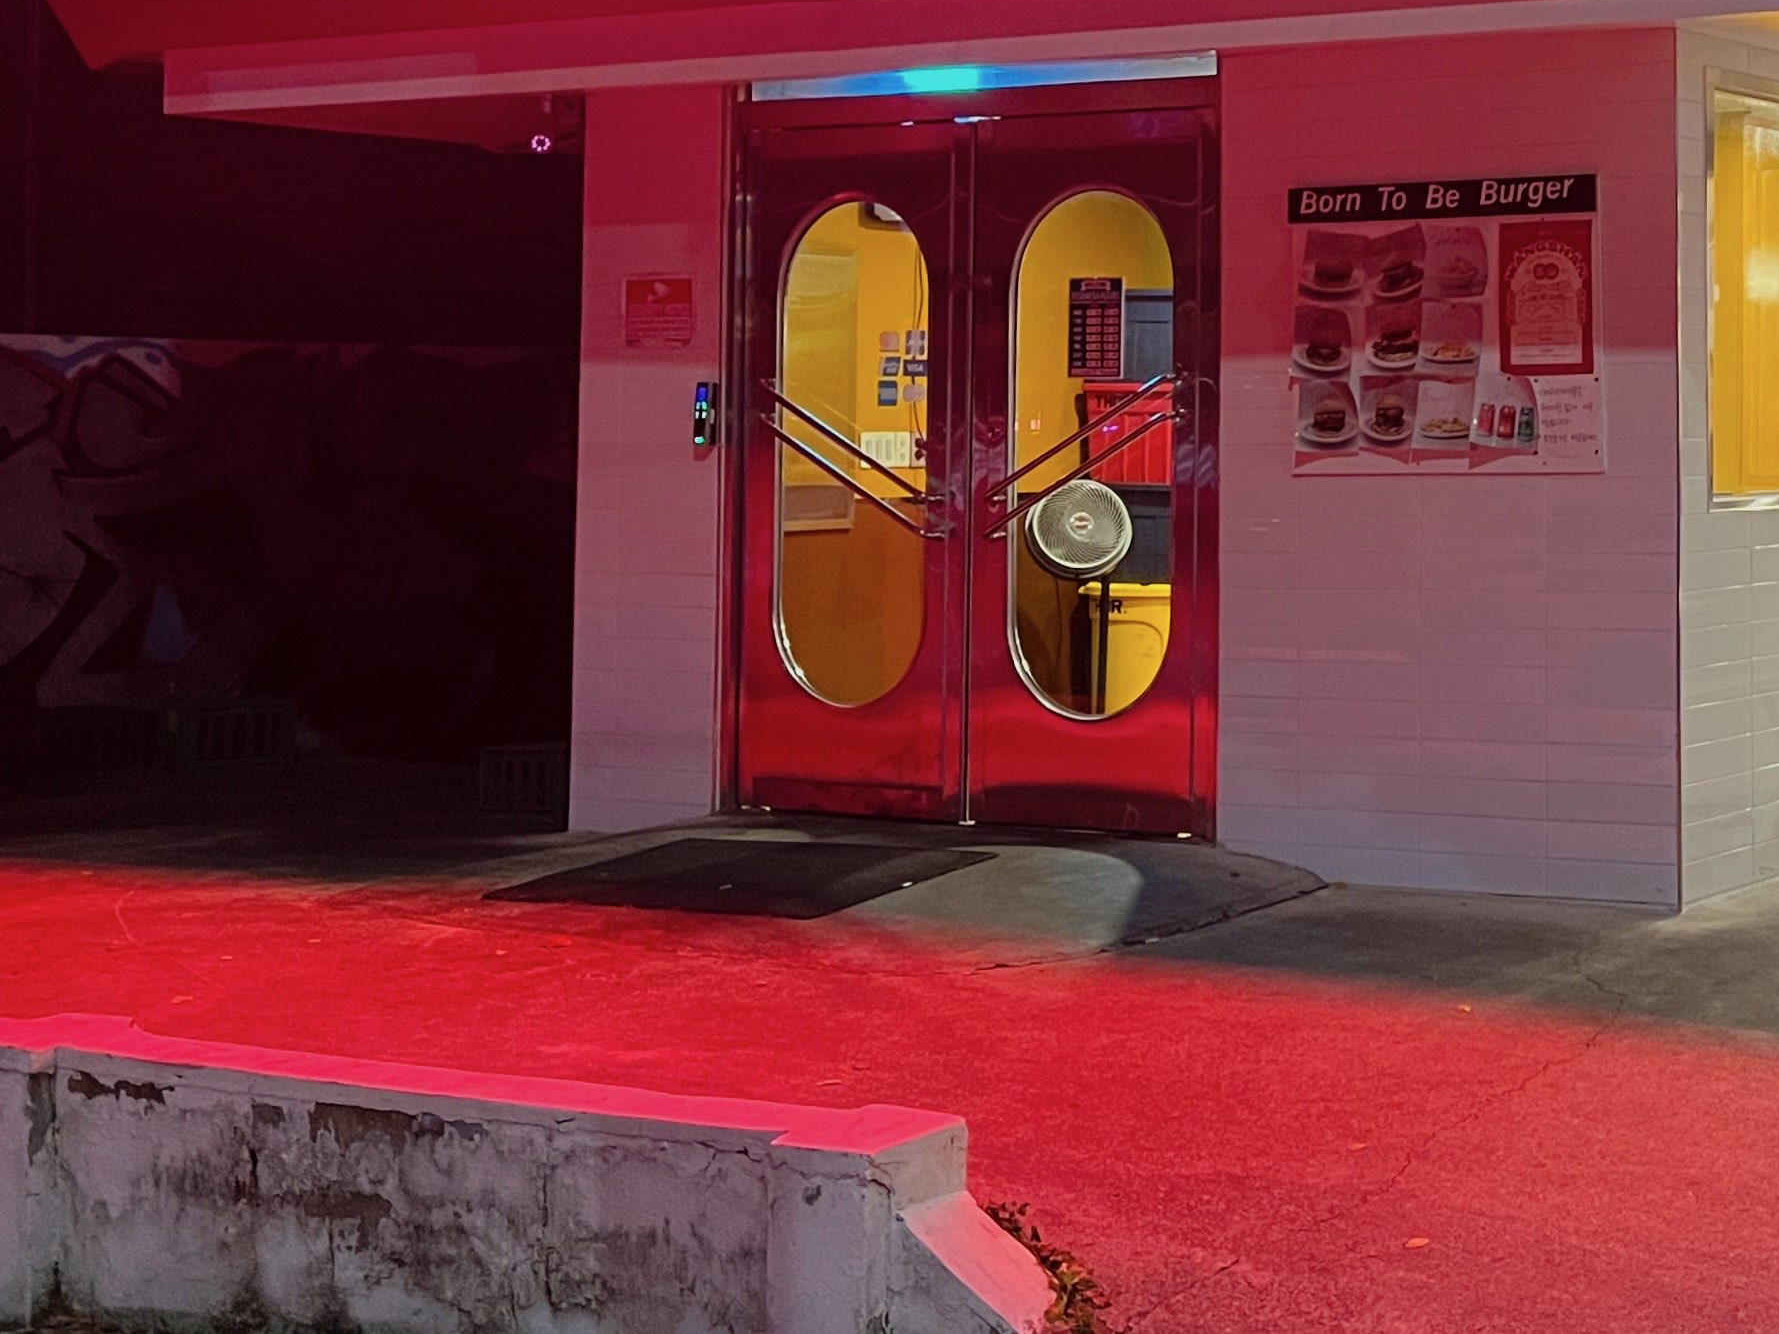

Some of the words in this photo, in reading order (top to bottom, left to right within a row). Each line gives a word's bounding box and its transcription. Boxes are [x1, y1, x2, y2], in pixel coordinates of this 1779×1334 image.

[1300, 190, 1361, 214] Born
[1378, 186, 1407, 211] To
[1426, 184, 1460, 209] Be
[1480, 178, 1574, 208] Burger
